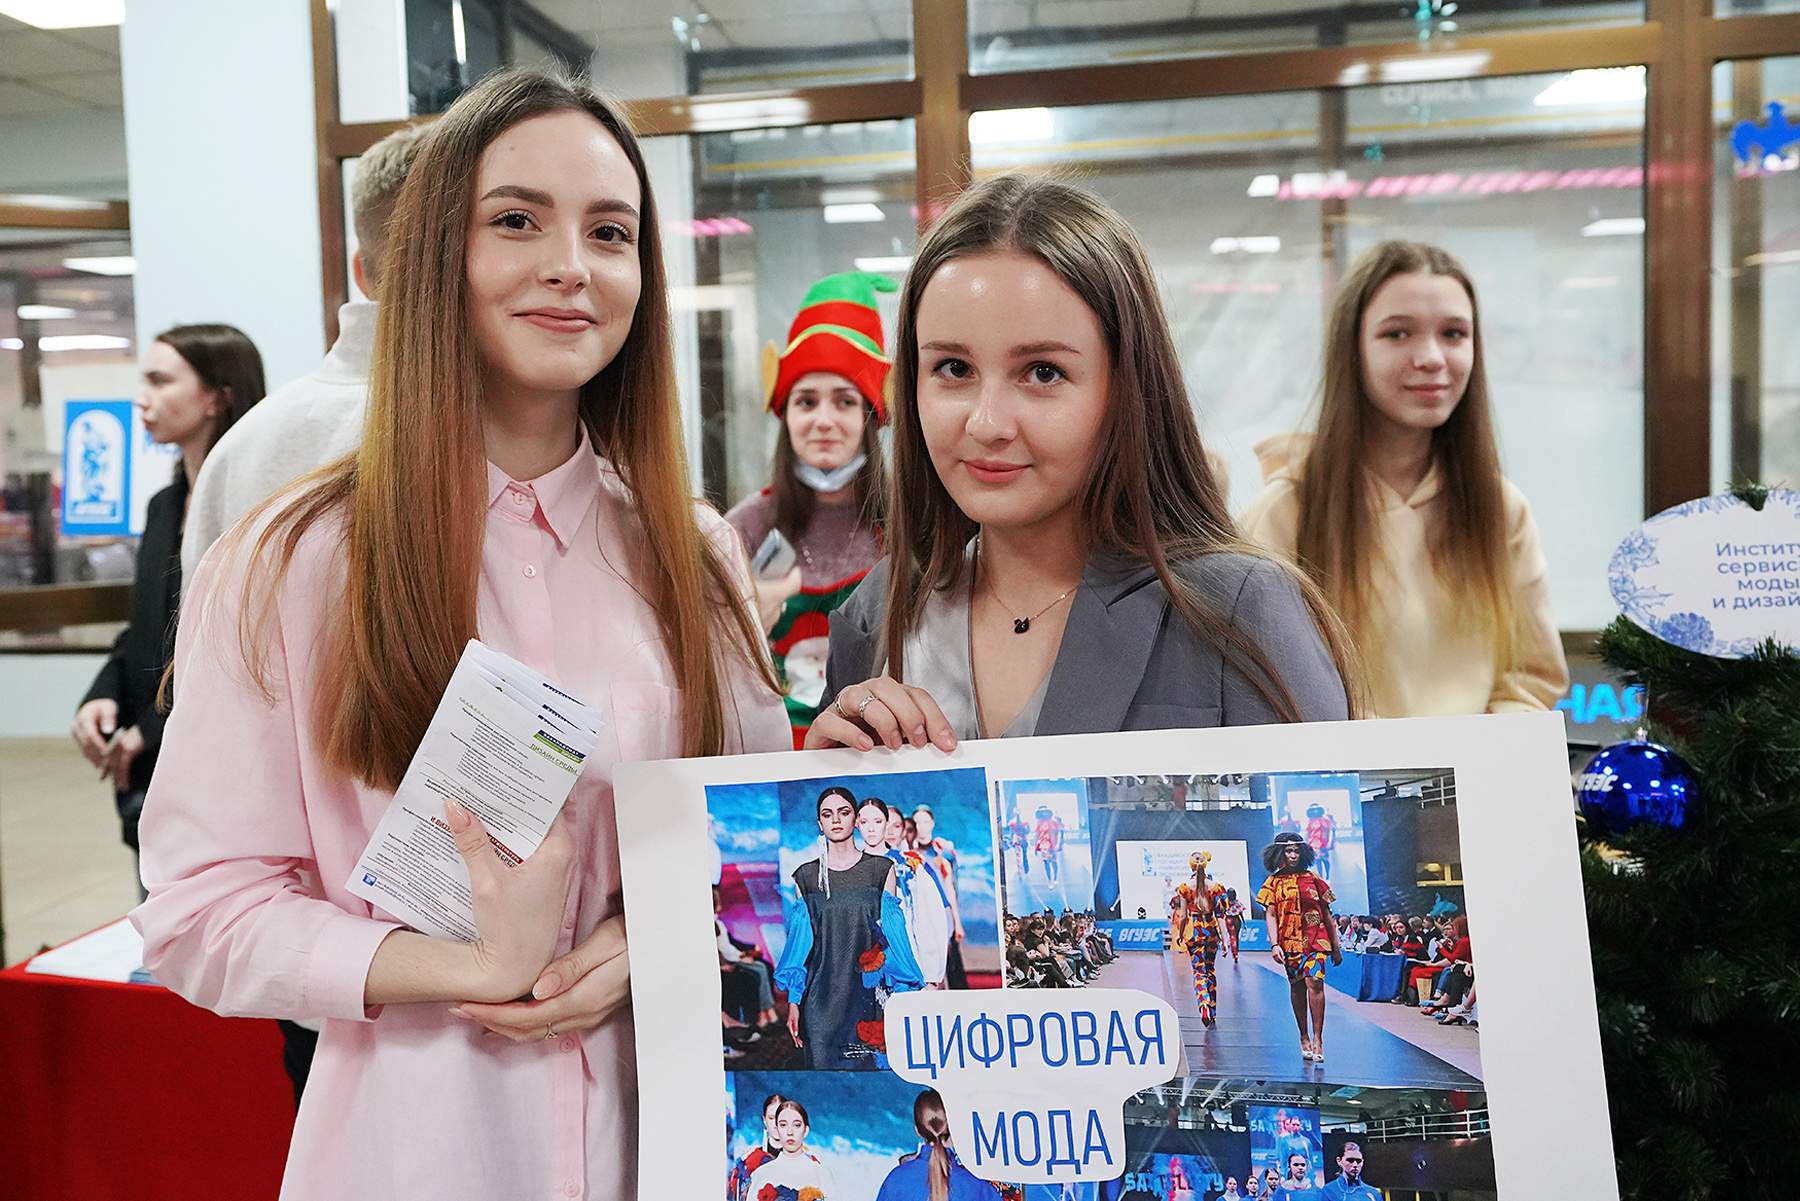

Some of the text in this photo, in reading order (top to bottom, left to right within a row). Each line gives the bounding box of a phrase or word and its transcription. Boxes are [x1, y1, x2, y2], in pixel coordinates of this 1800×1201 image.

[1716, 543, 1800, 557] Инстит
[1738, 578, 1800, 592] моды
[1712, 597, 1726, 609] и
[904, 1009, 1166, 1080] ЦИФРОВАЯ
[972, 1109, 1114, 1175] МОДА
